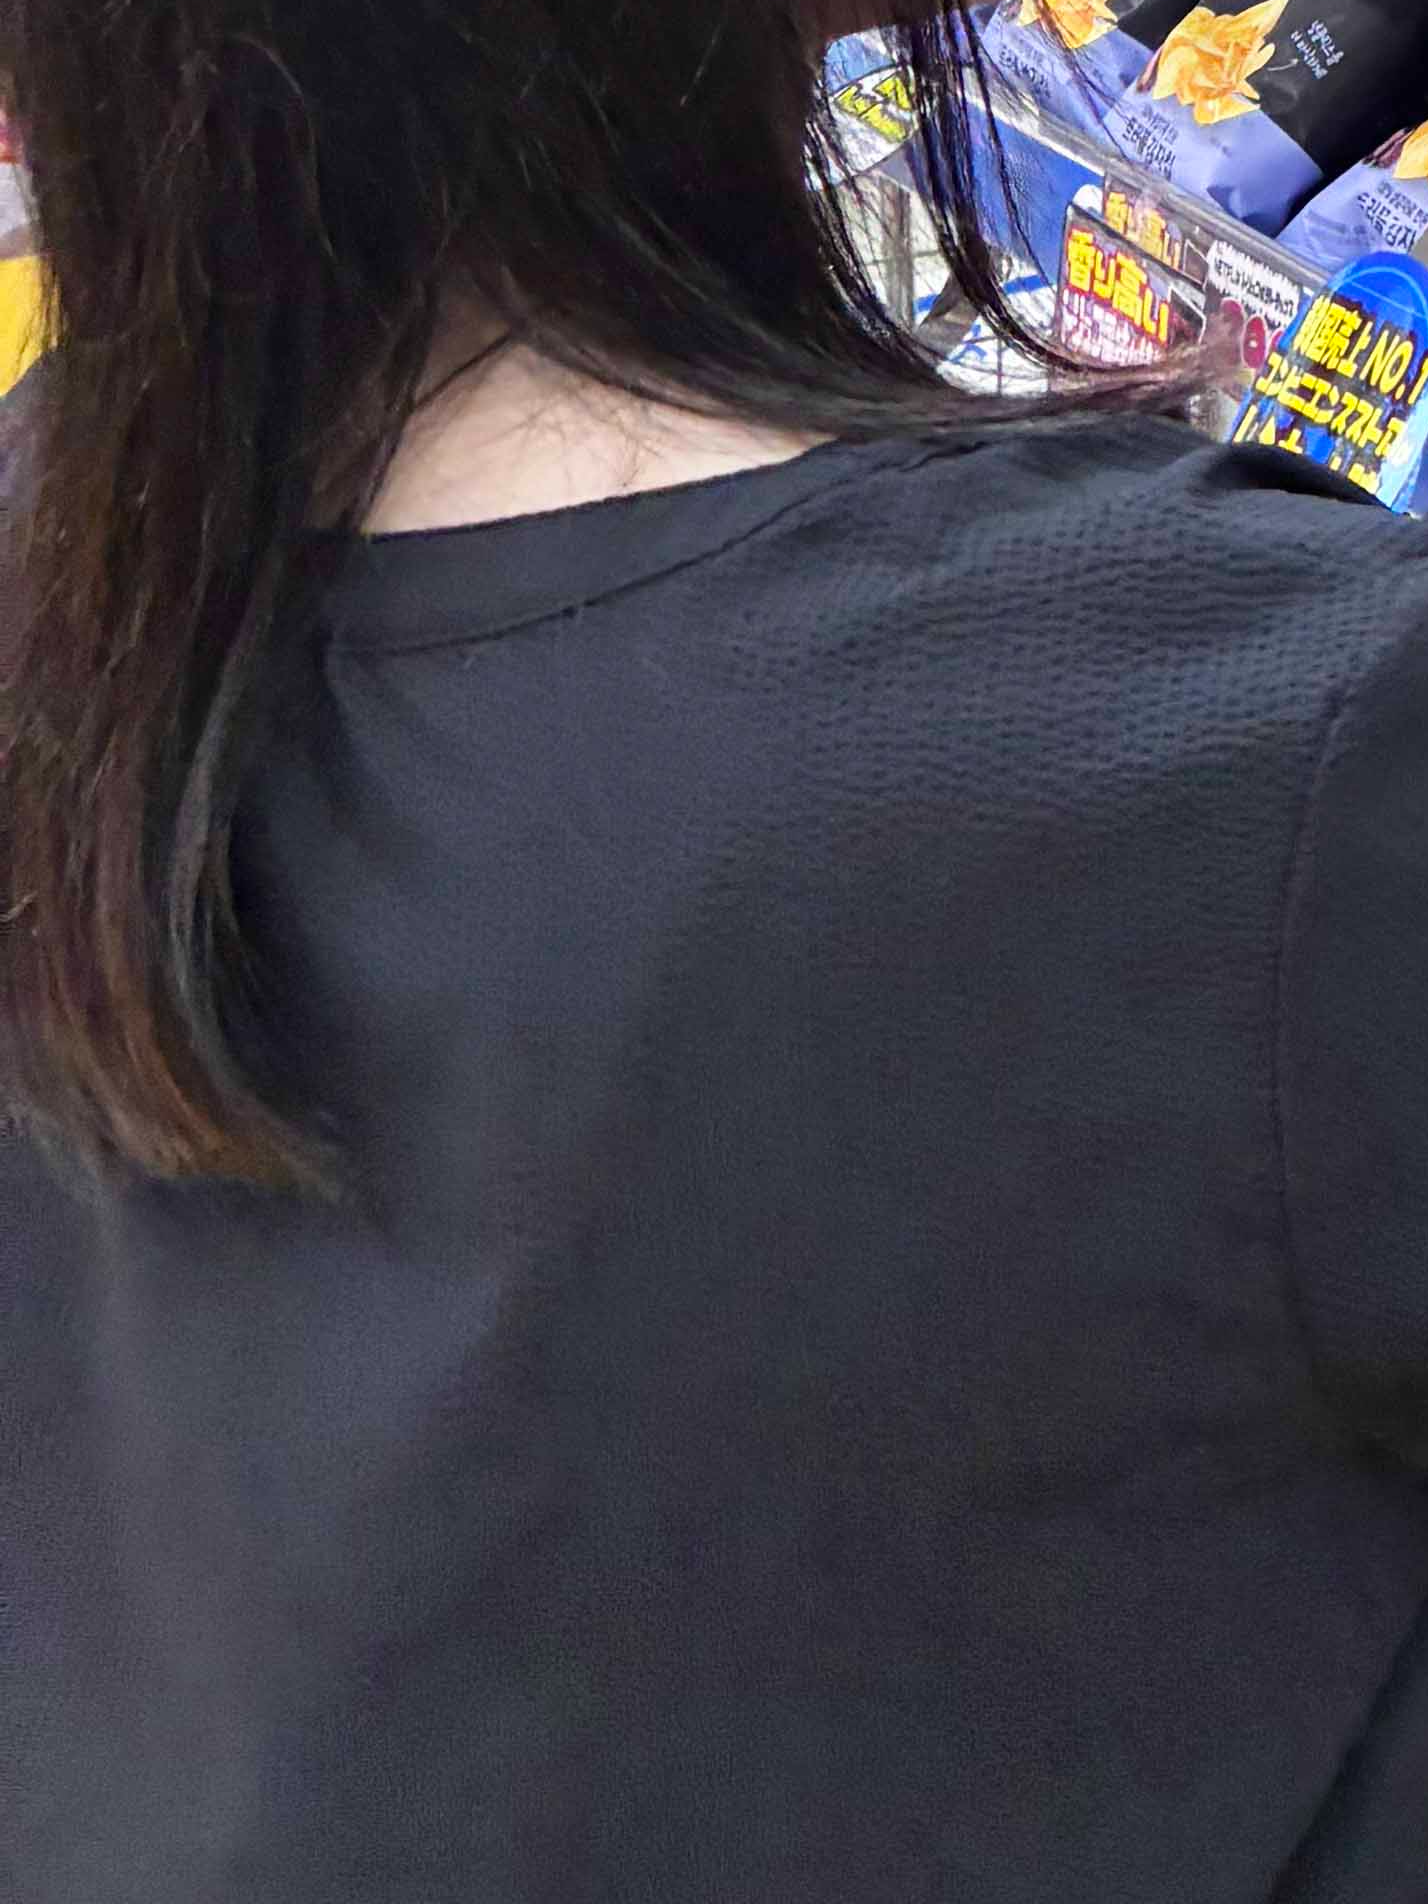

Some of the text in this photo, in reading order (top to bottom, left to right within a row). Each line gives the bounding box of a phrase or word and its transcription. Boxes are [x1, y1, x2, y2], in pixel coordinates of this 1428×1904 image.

[1066, 228, 1171, 345] 香り高い
[1255, 351, 1414, 463] コンビニエンスストア
